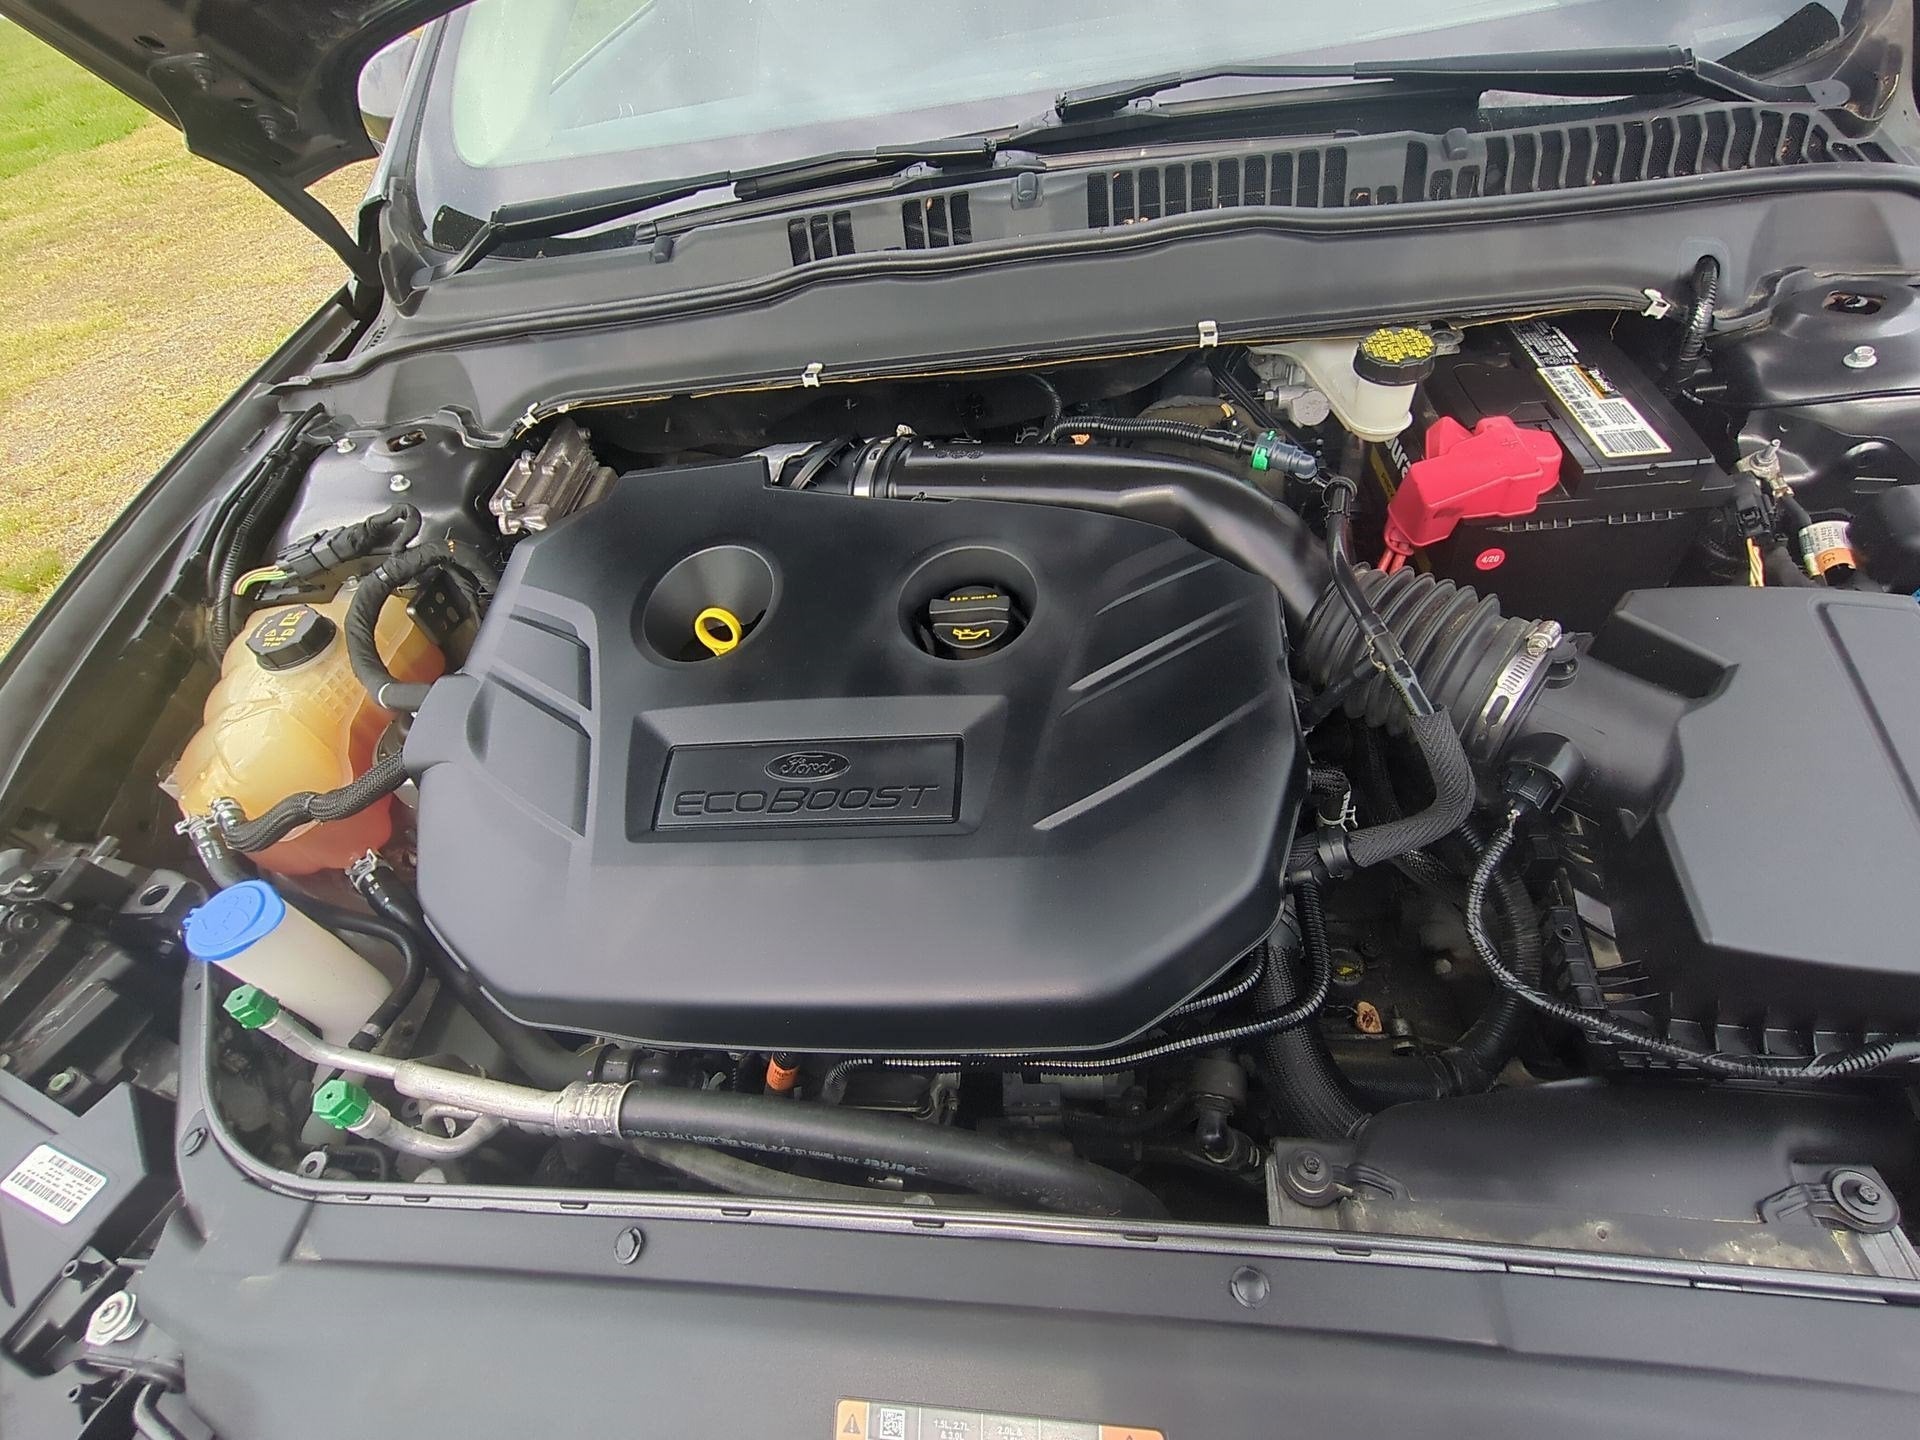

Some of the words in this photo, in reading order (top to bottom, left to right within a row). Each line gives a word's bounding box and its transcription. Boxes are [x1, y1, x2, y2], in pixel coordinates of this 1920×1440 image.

[1481, 555, 1500, 563] 4/20
[780, 754, 836, 774] Ford
[673, 785, 940, 817] ECOBOOST
[863, 1158, 916, 1174] Parker
